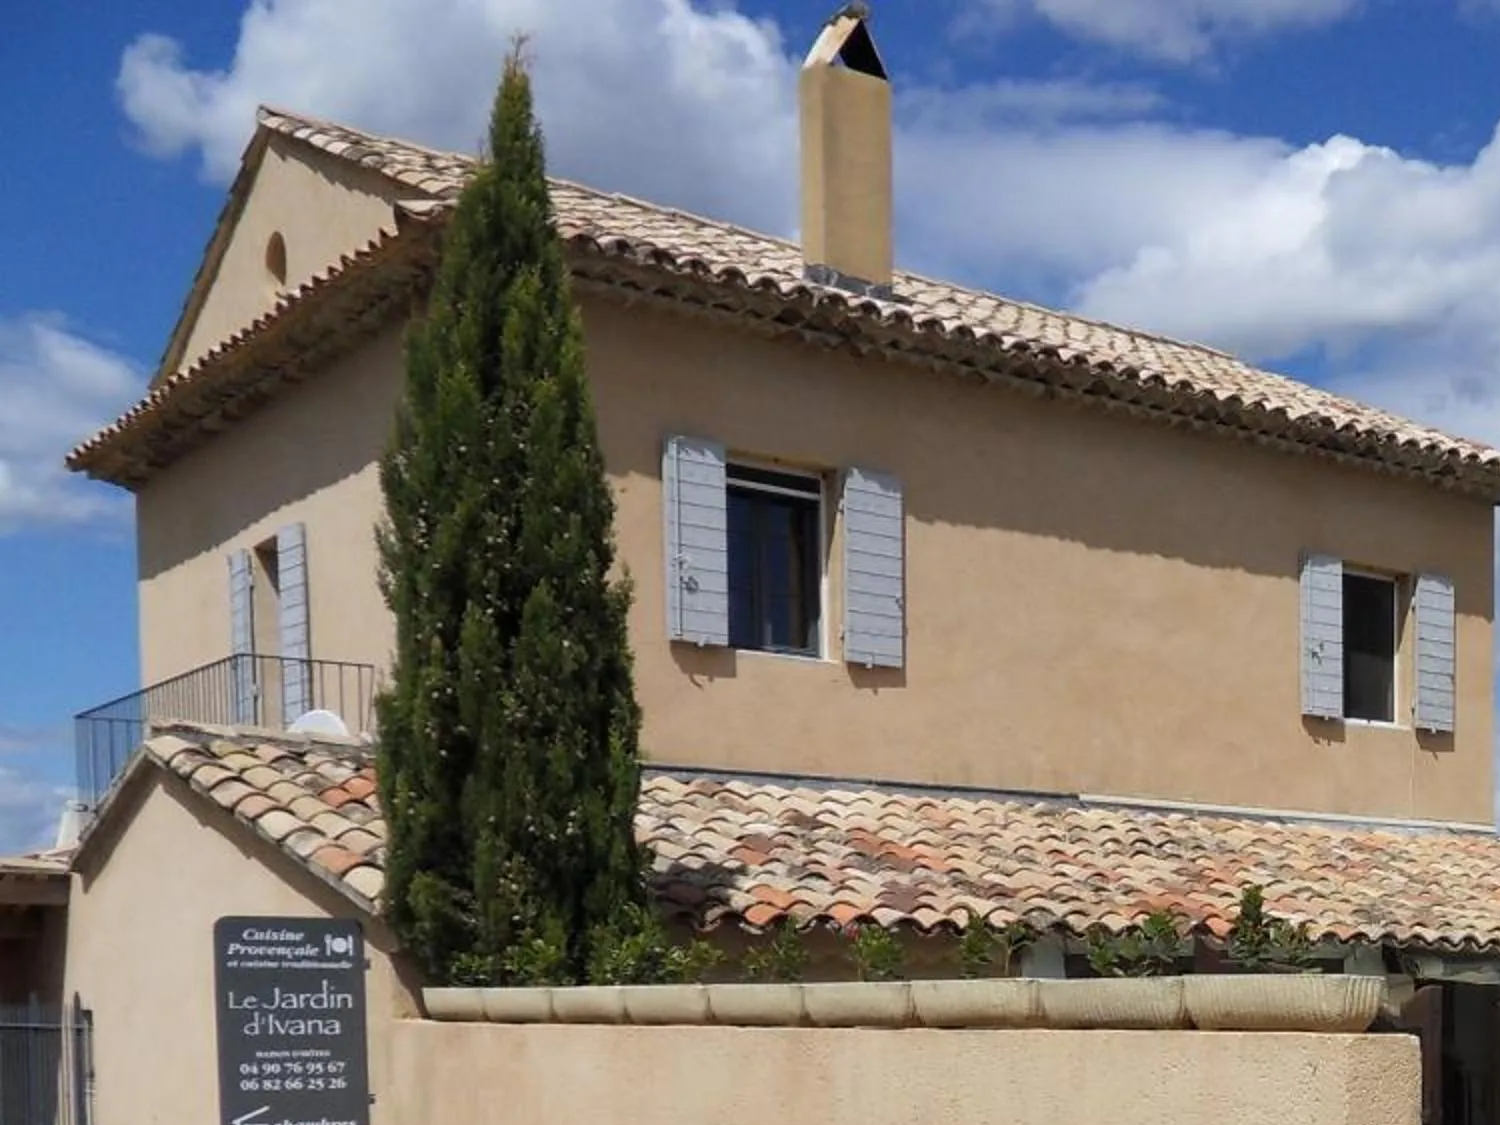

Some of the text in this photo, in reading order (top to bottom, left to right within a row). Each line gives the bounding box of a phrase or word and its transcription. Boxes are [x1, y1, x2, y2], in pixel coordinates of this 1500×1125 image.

[242, 928, 305, 941] Cuisine
[227, 943, 320, 959] Provençale
[228, 979, 353, 1009] Le Jardin
[243, 1011, 342, 1035] d'Ivana
[261, 1063, 281, 1075] 90
[283, 1062, 304, 1074] 76
[327, 1061, 346, 1074] 67
[239, 1079, 260, 1091] 06
[262, 1079, 281, 1090] 82
[284, 1078, 304, 1090] 66
